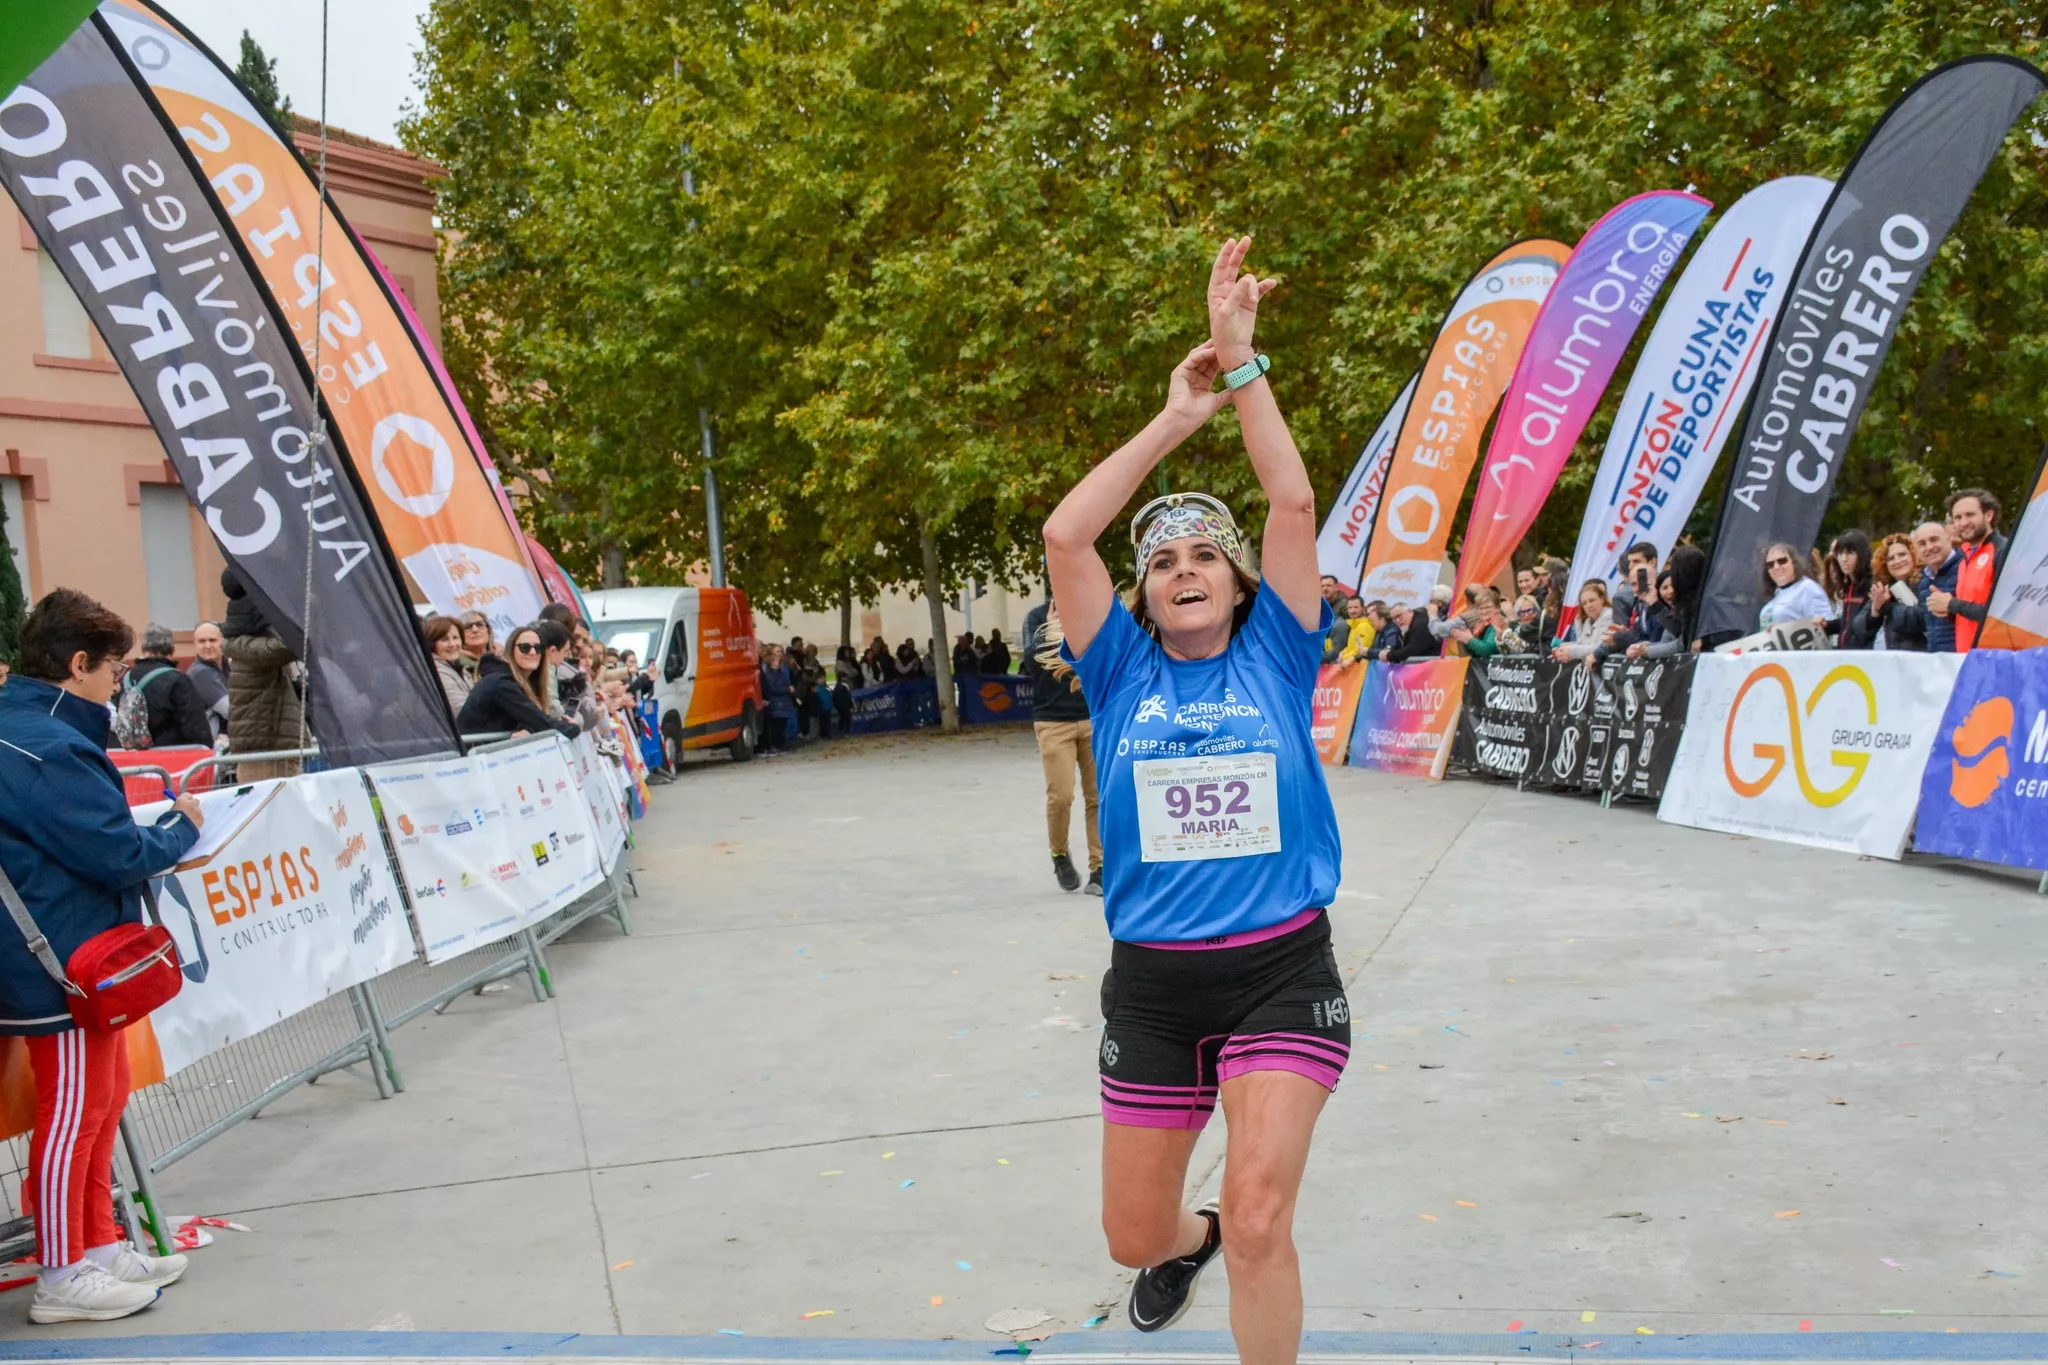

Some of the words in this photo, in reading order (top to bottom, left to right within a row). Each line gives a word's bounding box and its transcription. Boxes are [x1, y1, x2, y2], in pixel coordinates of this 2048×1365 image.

[1629, 231, 1689, 316] ENERGÍA
[1521, 221, 1669, 446] alumbra
[1672, 300, 1732, 394] CUNA
[1785, 213, 1930, 494] CABRERO
[1412, 314, 1495, 469] ESPIAS
[1439, 331, 1509, 471] CONSTRUCTORA
[1633, 483, 1669, 531] DE
[1658, 266, 1775, 482] DEPORTISTAS
[1733, 245, 1854, 513] Automóviles
[1340, 440, 1397, 546] MONZÓ
[1133, 739, 1187, 752] ESPIAS
[1148, 779, 1181, 787] CARRERA
[1182, 776, 1222, 786] EMPRESAS
[1223, 772, 1256, 782] MONZÓN
[1256, 771, 1268, 779] CM
[1197, 739, 1246, 756] CABRERO
[1476, 740, 1530, 774] CABRERO
[1831, 729, 1872, 748] GRUPO
[1165, 780, 1252, 819] 952
[1181, 818, 1240, 835] MARIA
[202, 846, 320, 926] ESPIAS
